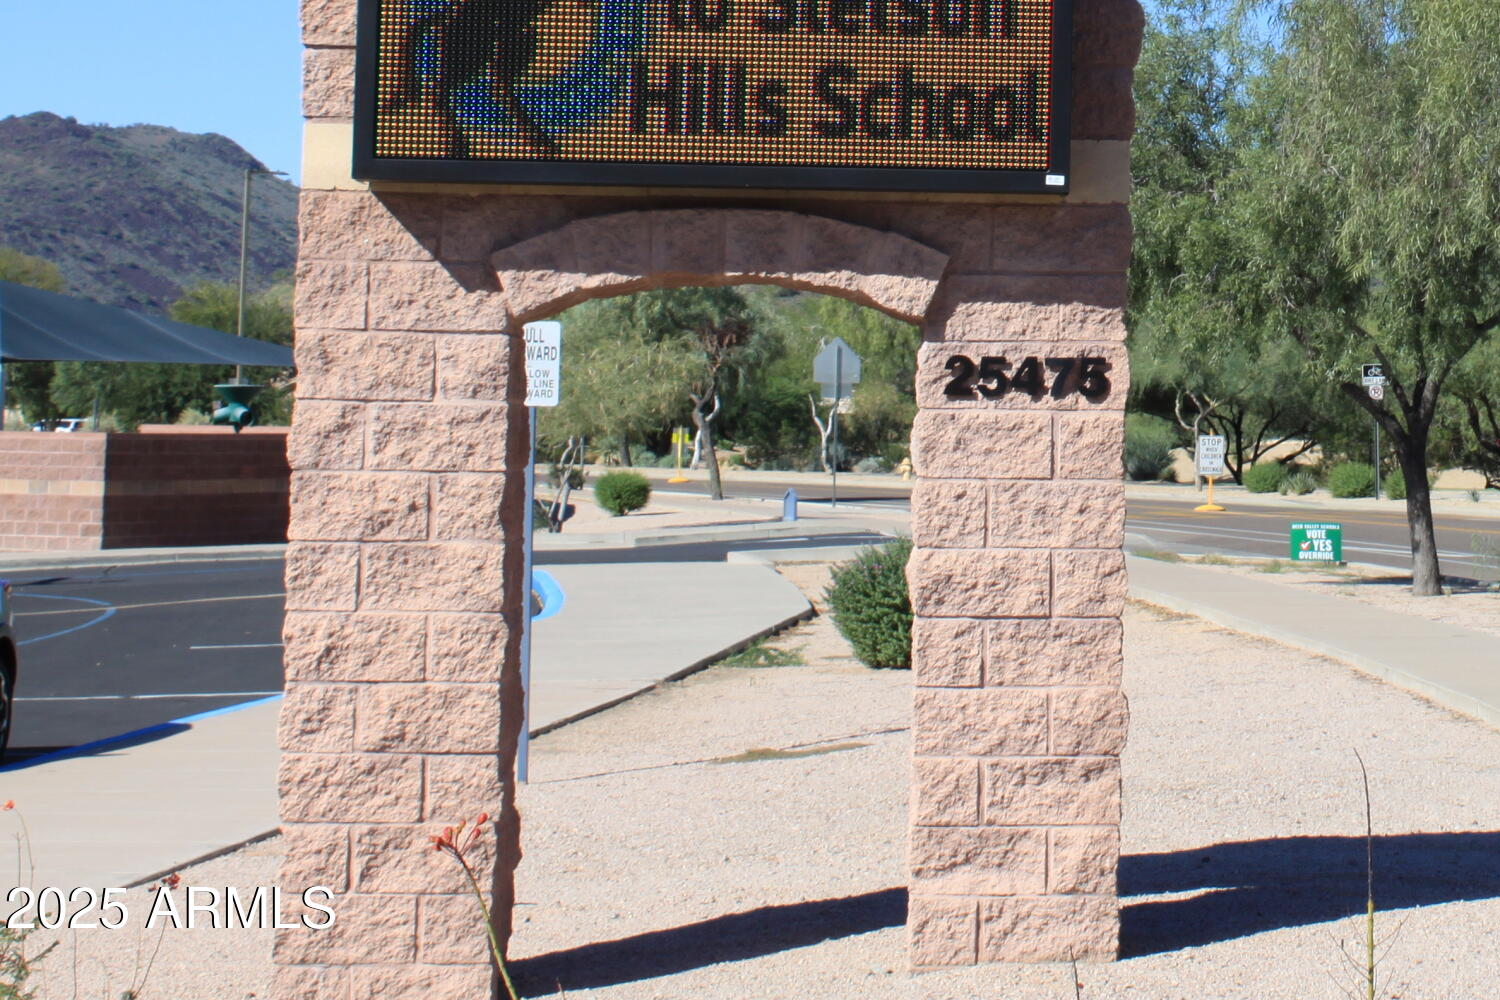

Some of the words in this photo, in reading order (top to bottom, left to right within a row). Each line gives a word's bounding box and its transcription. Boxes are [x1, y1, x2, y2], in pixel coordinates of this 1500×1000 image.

[627, 56, 789, 138] Hills
[810, 59, 1041, 143] School
[525, 327, 545, 344] ULL
[526, 346, 558, 361] WARD
[528, 369, 550, 379] LOW
[943, 354, 1111, 402] 25475
[533, 379, 554, 389] LINE
[1201, 438, 1222, 447] STOP
[1305, 529, 1328, 539] VOTE
[1312, 539, 1333, 551] YES
[1298, 551, 1335, 560] OVERRIDE
